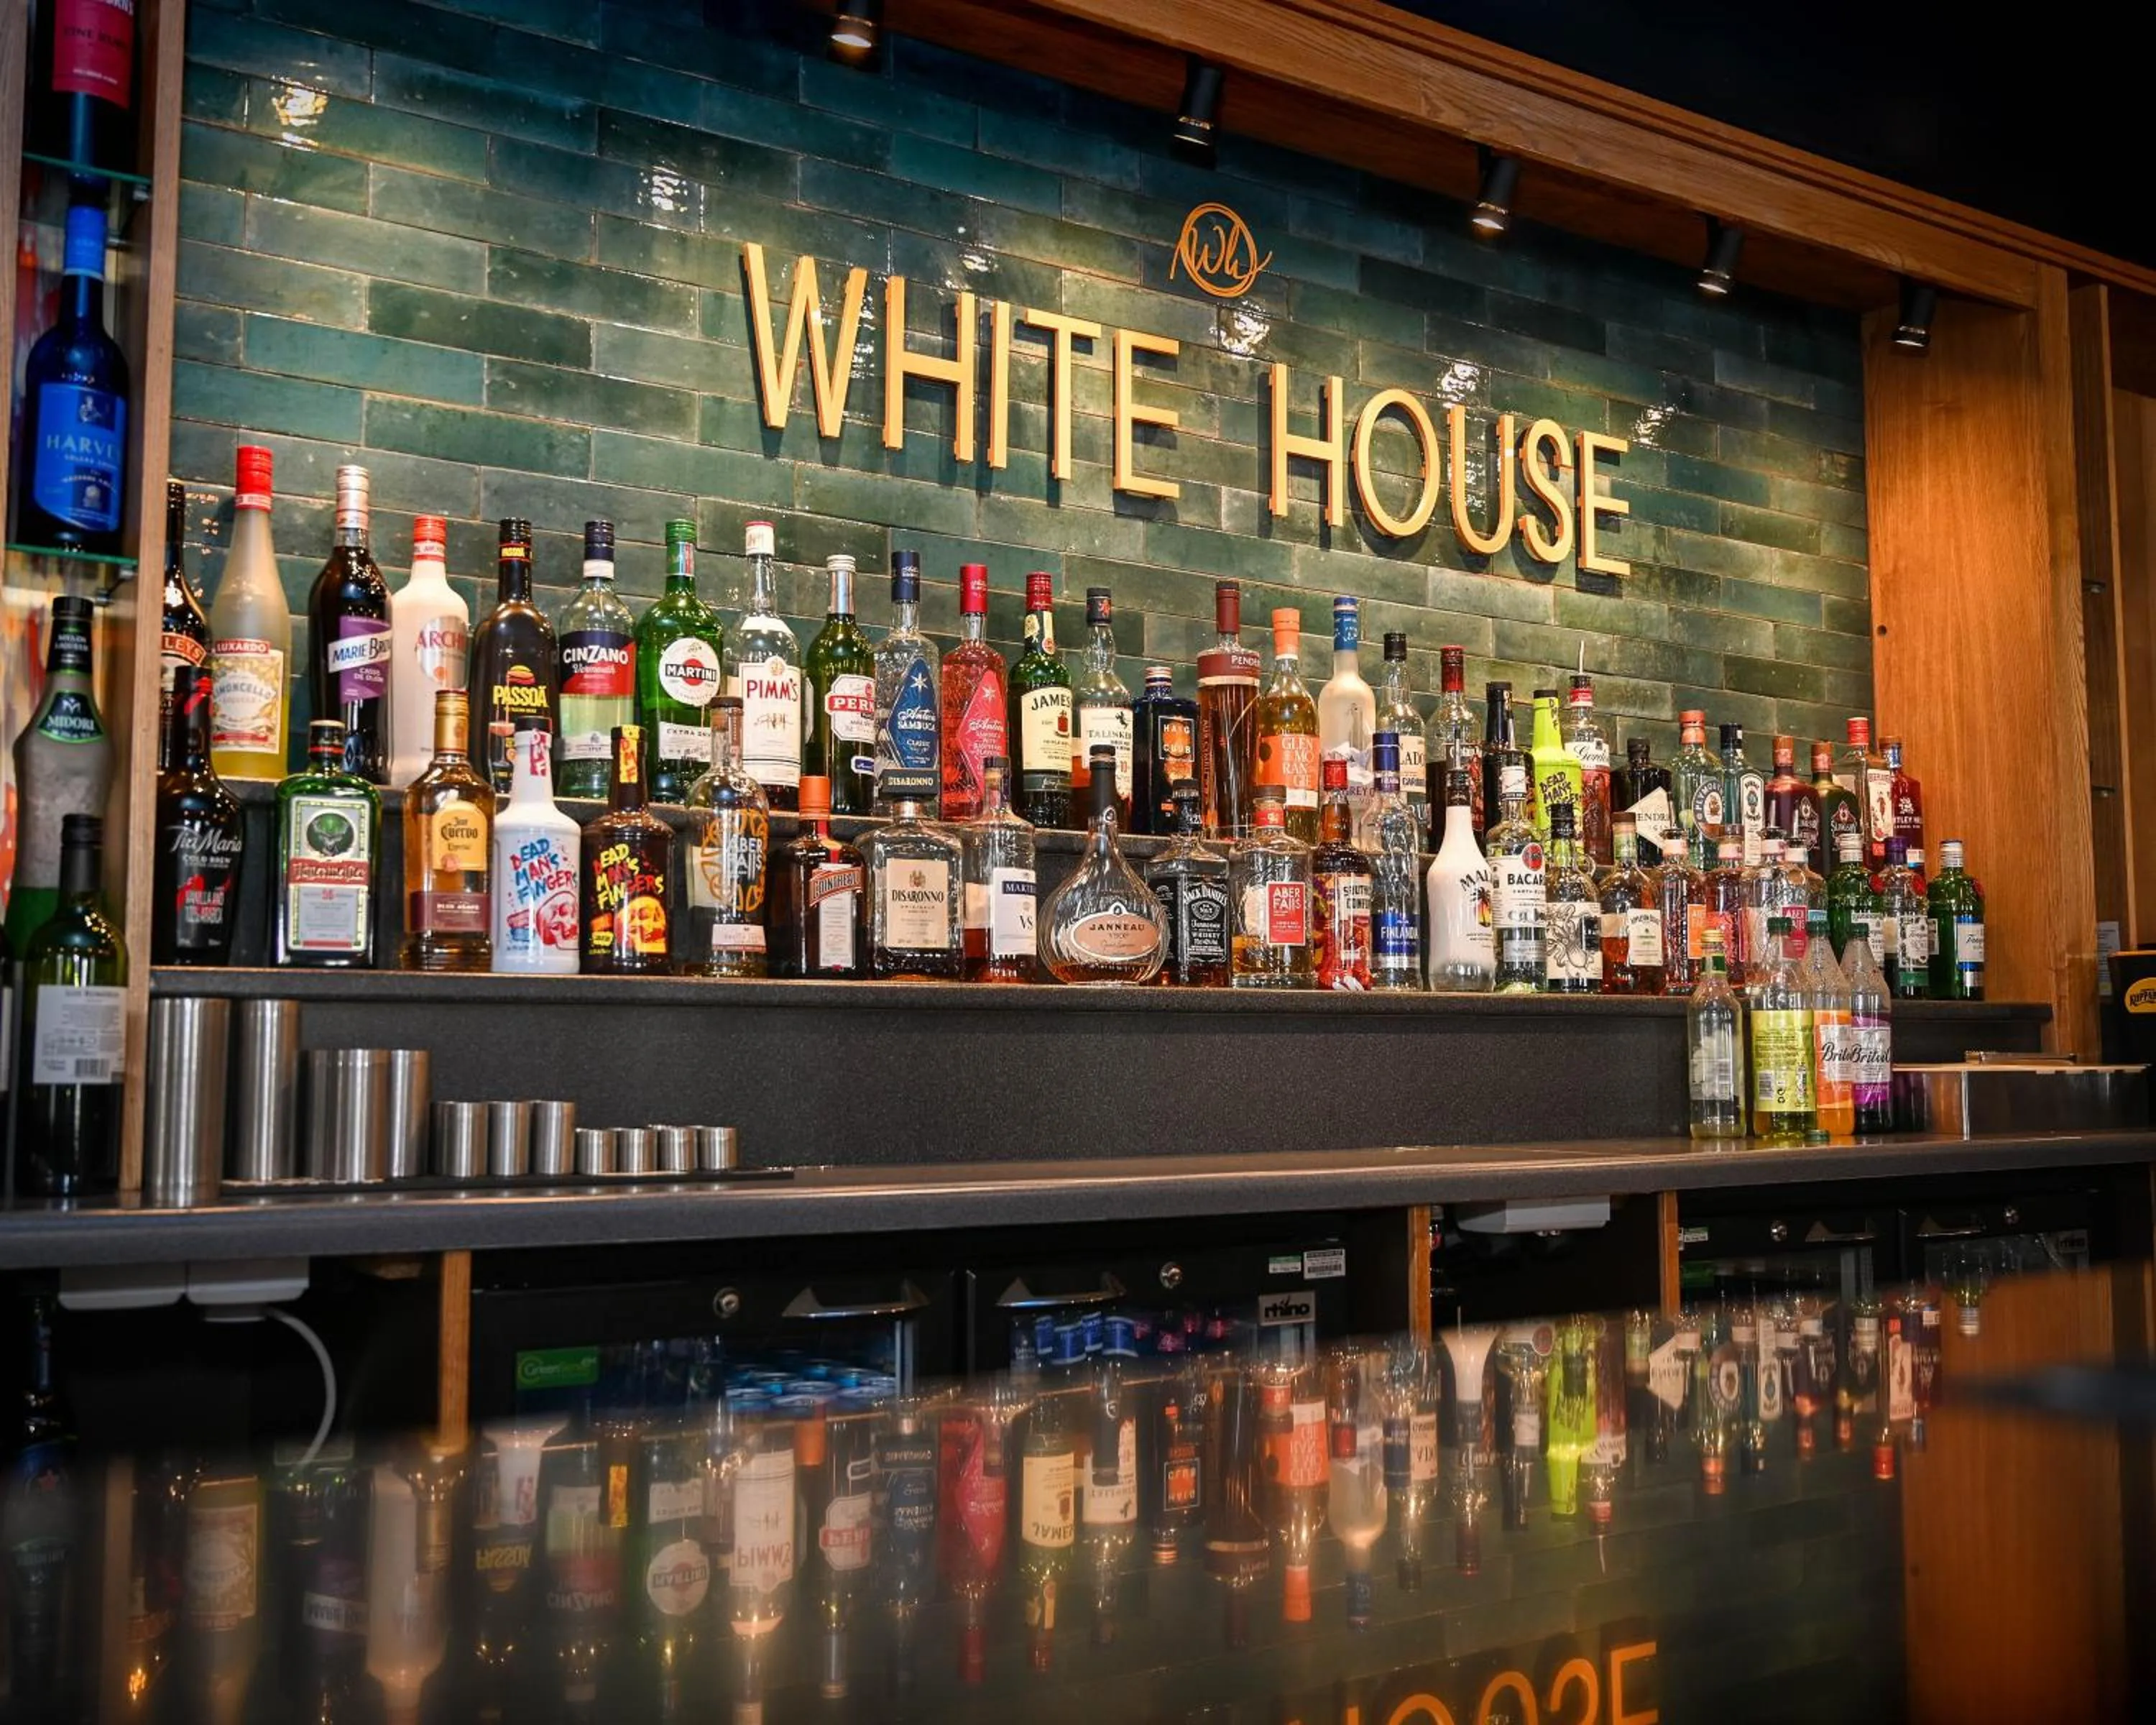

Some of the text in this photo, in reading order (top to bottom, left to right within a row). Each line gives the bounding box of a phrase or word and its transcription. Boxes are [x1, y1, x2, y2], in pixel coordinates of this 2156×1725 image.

[743, 242, 1179, 500] WHITE
[1269, 363, 1631, 575] HOUSE
[216, 641, 267, 654] LUXARDO
[333, 644, 365, 663] MARIE
[563, 645, 628, 665] CINZANO
[665, 664, 717, 682] MARTINI
[746, 678, 799, 702] PIMM'S
[47, 714, 95, 732] MIDORI
[898, 720, 936, 731] SAMBUCA
[888, 776, 934, 786] DISARONNO
[441, 827, 478, 841] Cuervo
[510, 838, 550, 871] DEAD
[593, 843, 629, 875] DEAD
[515, 852, 559, 886] MAN'S
[596, 857, 639, 893] MAN'S
[598, 873, 663, 909] FINGERS
[891, 889, 944, 903] DISARONNO
[1273, 886, 1300, 898] ABER
[1089, 923, 1145, 932] JANNEAU
[1264, 1294, 1310, 1317] rhino
